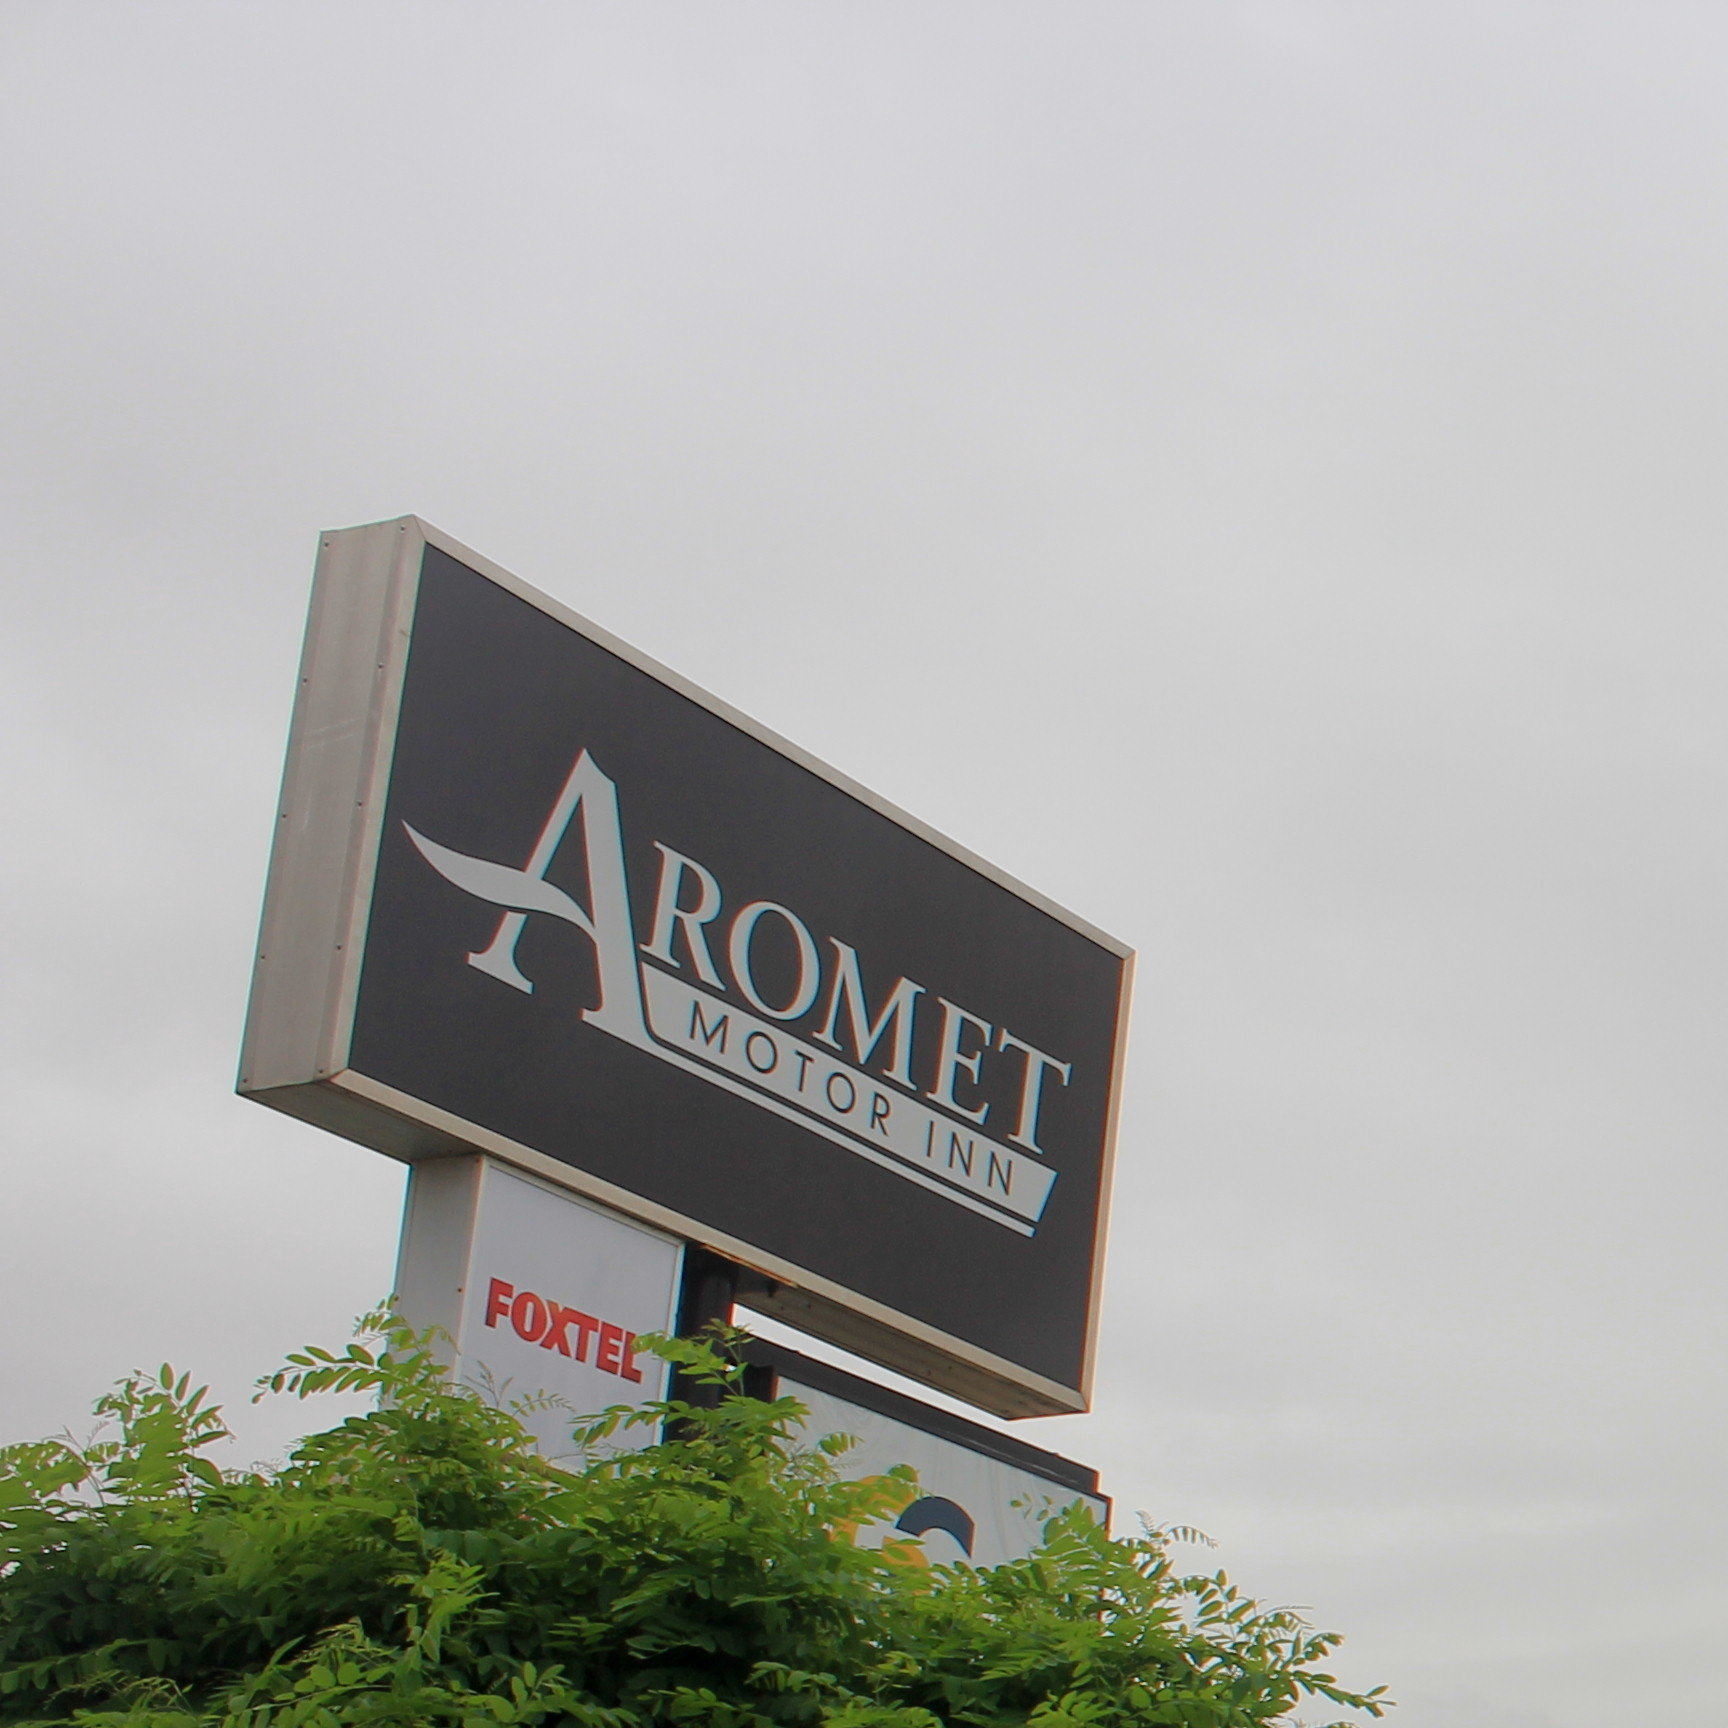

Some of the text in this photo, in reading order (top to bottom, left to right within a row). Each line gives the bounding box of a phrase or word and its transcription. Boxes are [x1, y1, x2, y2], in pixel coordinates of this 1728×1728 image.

[402, 747, 1072, 1156] AROMET
[688, 998, 1013, 1197] MOTOR INN
[484, 1276, 643, 1385] FOXTEL
